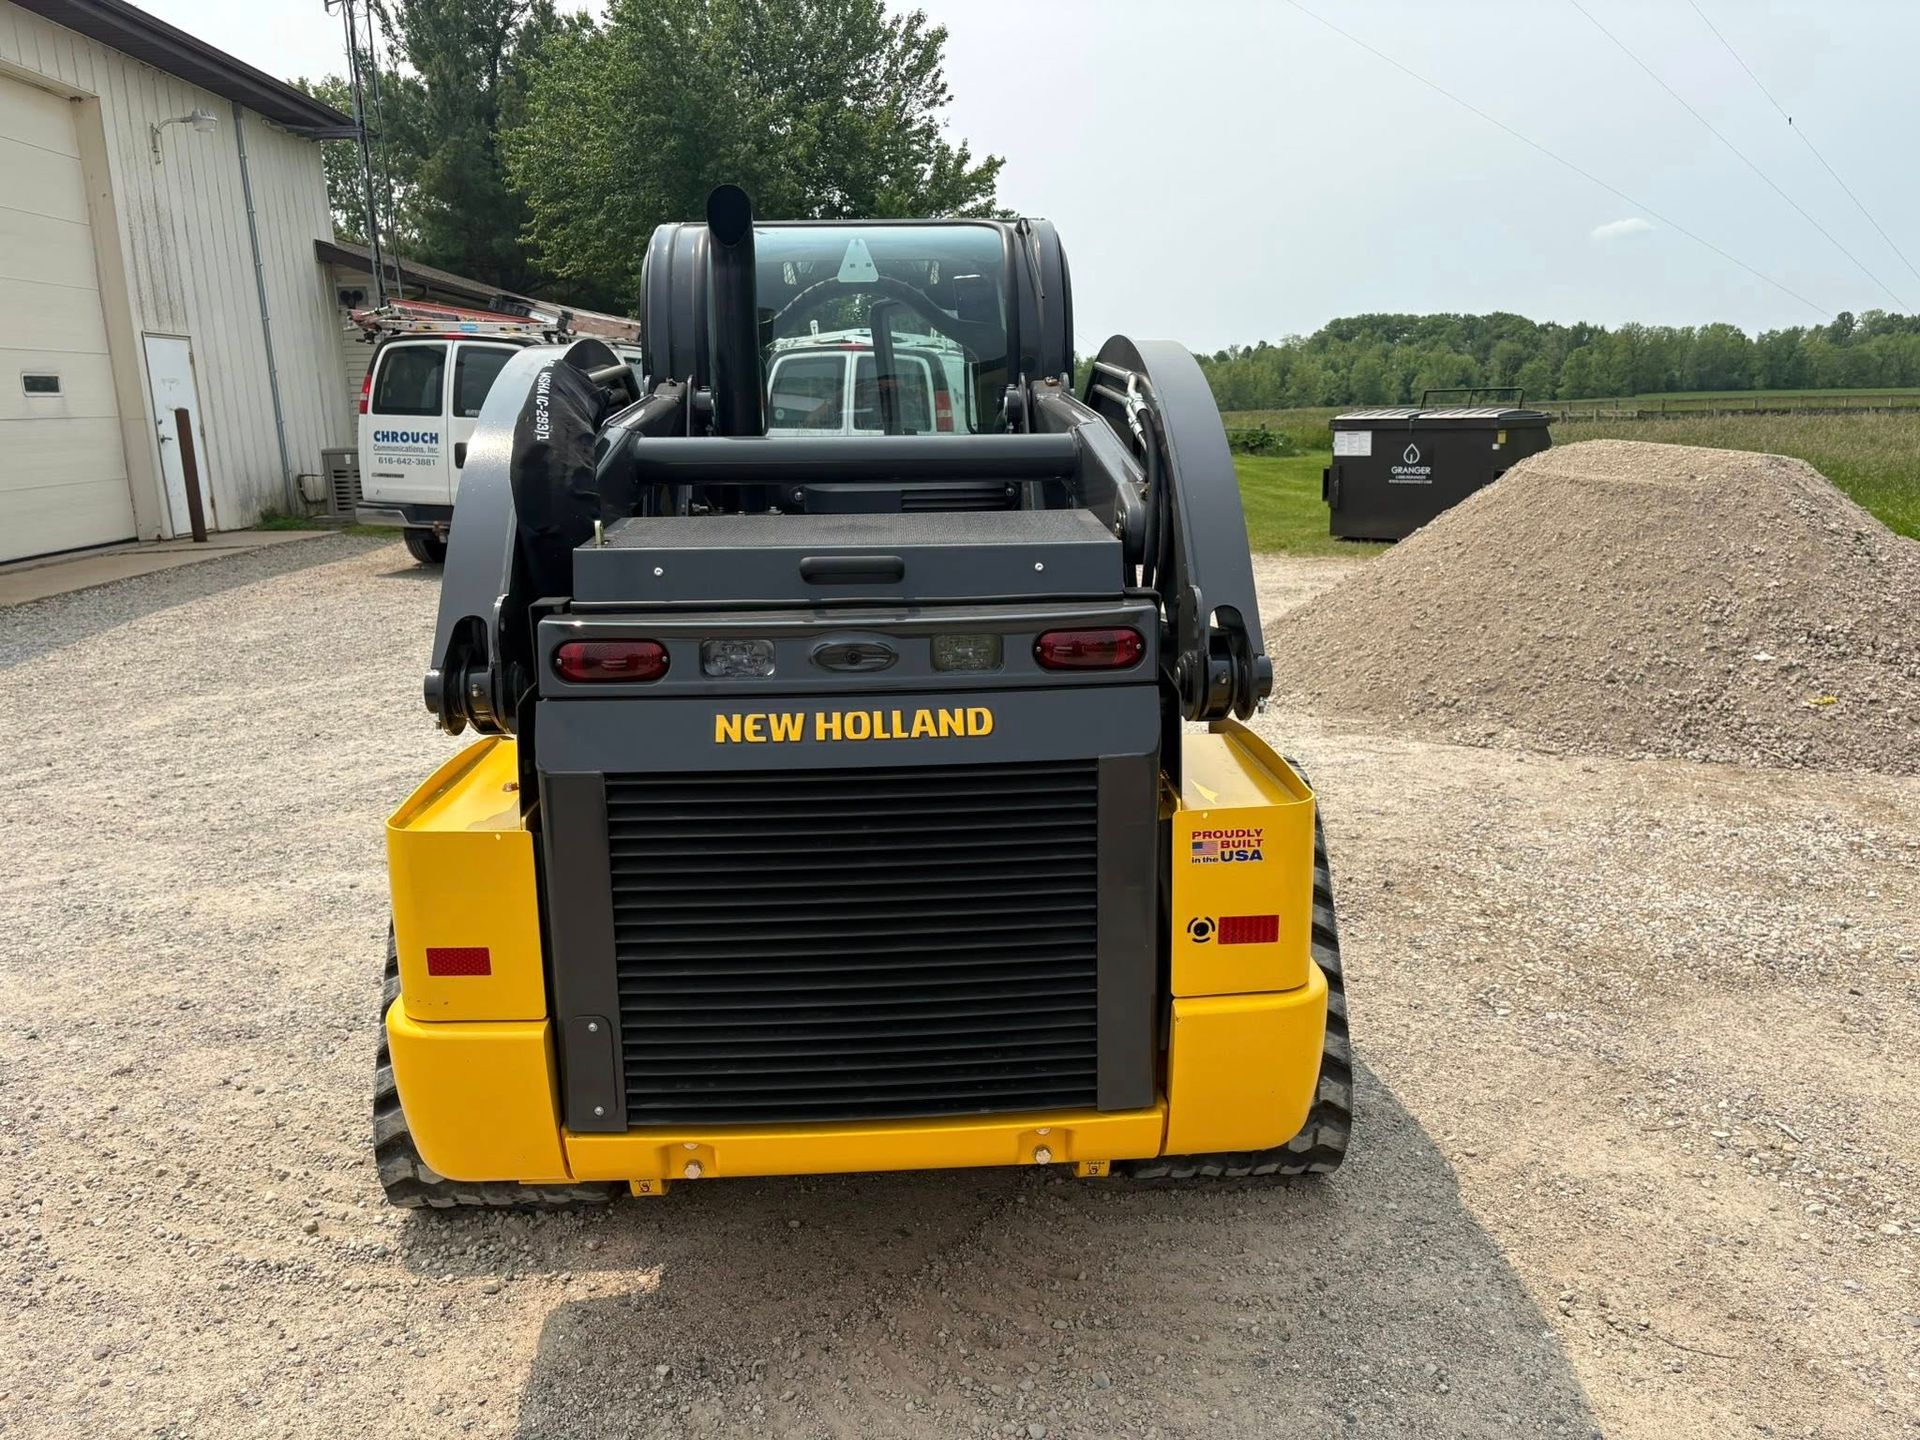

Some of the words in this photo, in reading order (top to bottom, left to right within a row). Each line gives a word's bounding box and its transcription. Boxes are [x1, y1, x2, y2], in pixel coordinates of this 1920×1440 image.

[534, 395, 550, 441] IC-293/1
[373, 431, 439, 444] CHROUCH
[373, 444, 426, 453] Communications,
[427, 446, 440, 454] Inc.
[378, 457, 436, 466] 616-642-3881
[1391, 466, 1431, 475] GRANGER
[715, 713, 804, 743] NEW
[815, 707, 994, 741] HOLLAND
[1192, 829, 1263, 840] PROUDLY
[1220, 839, 1264, 849] BUILT
[1220, 849, 1263, 862] USA
